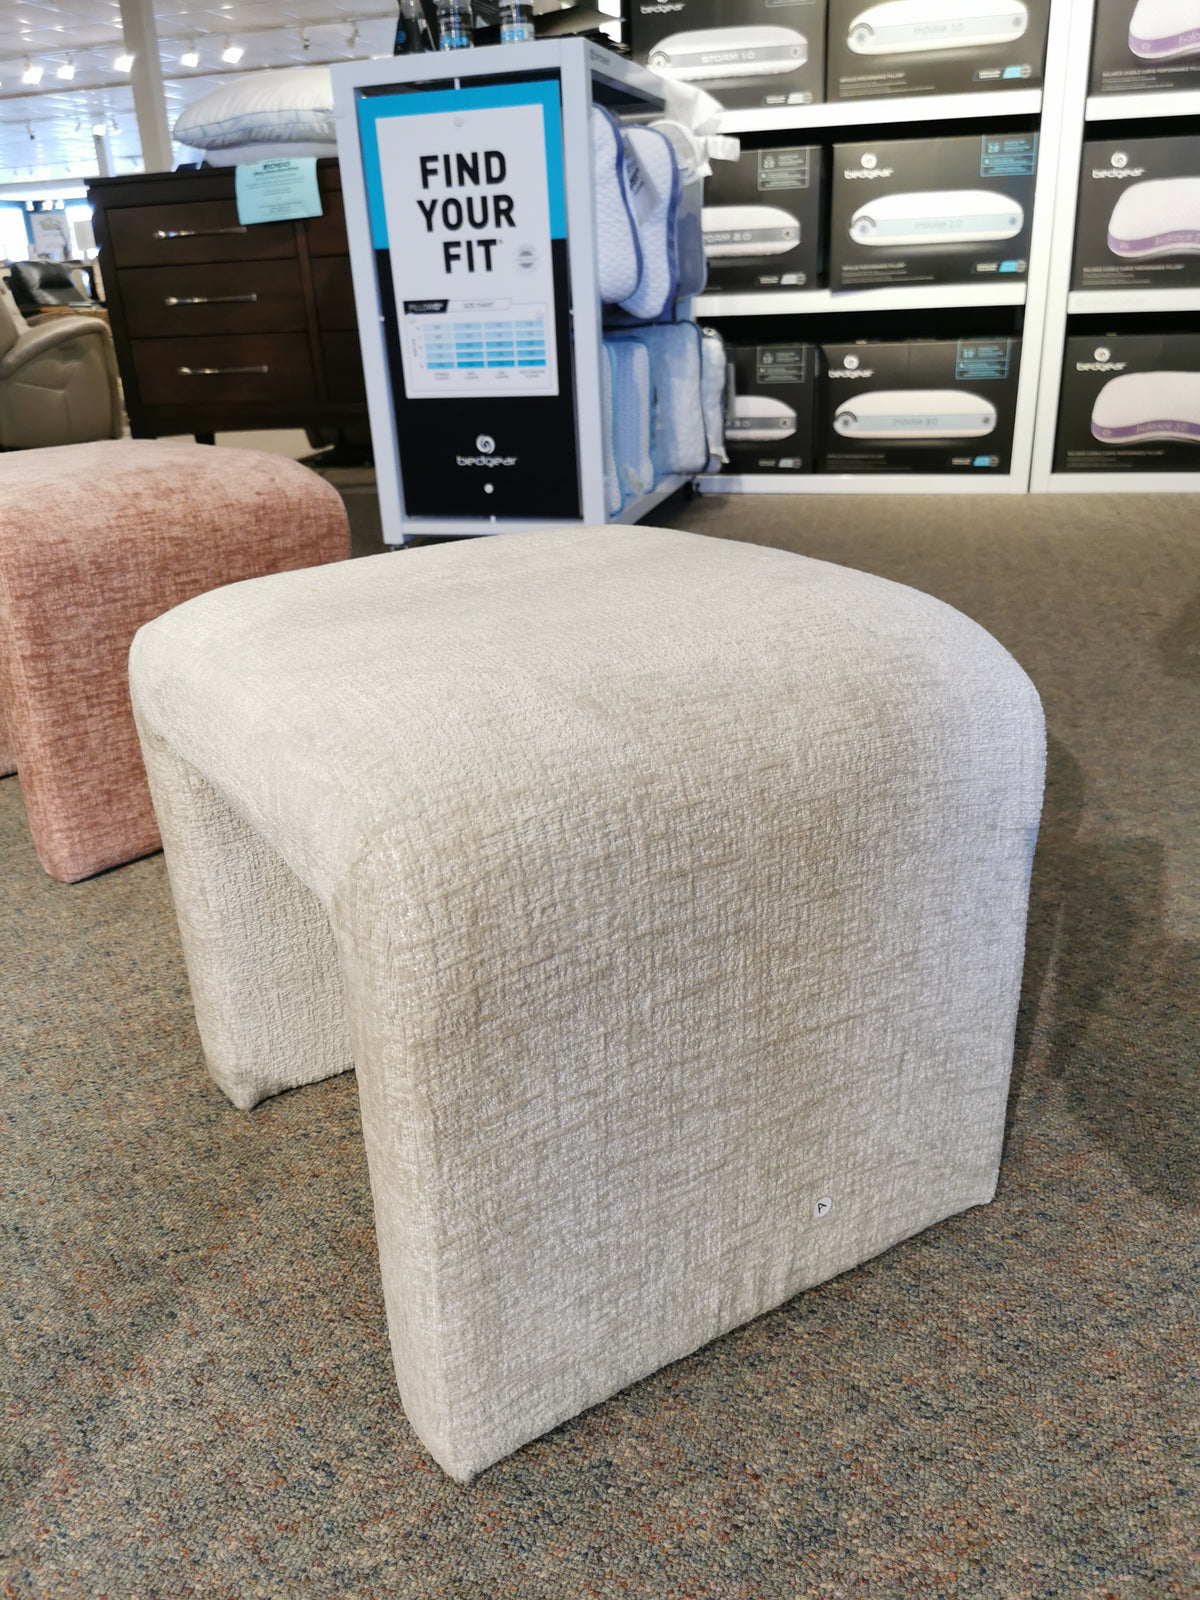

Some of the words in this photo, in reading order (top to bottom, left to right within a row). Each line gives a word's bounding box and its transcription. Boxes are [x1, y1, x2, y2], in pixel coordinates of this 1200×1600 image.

[419, 150, 507, 189] FIND
[417, 194, 516, 232] YOUR
[443, 239, 497, 274] FIT
[456, 455, 518, 468] bedgear
